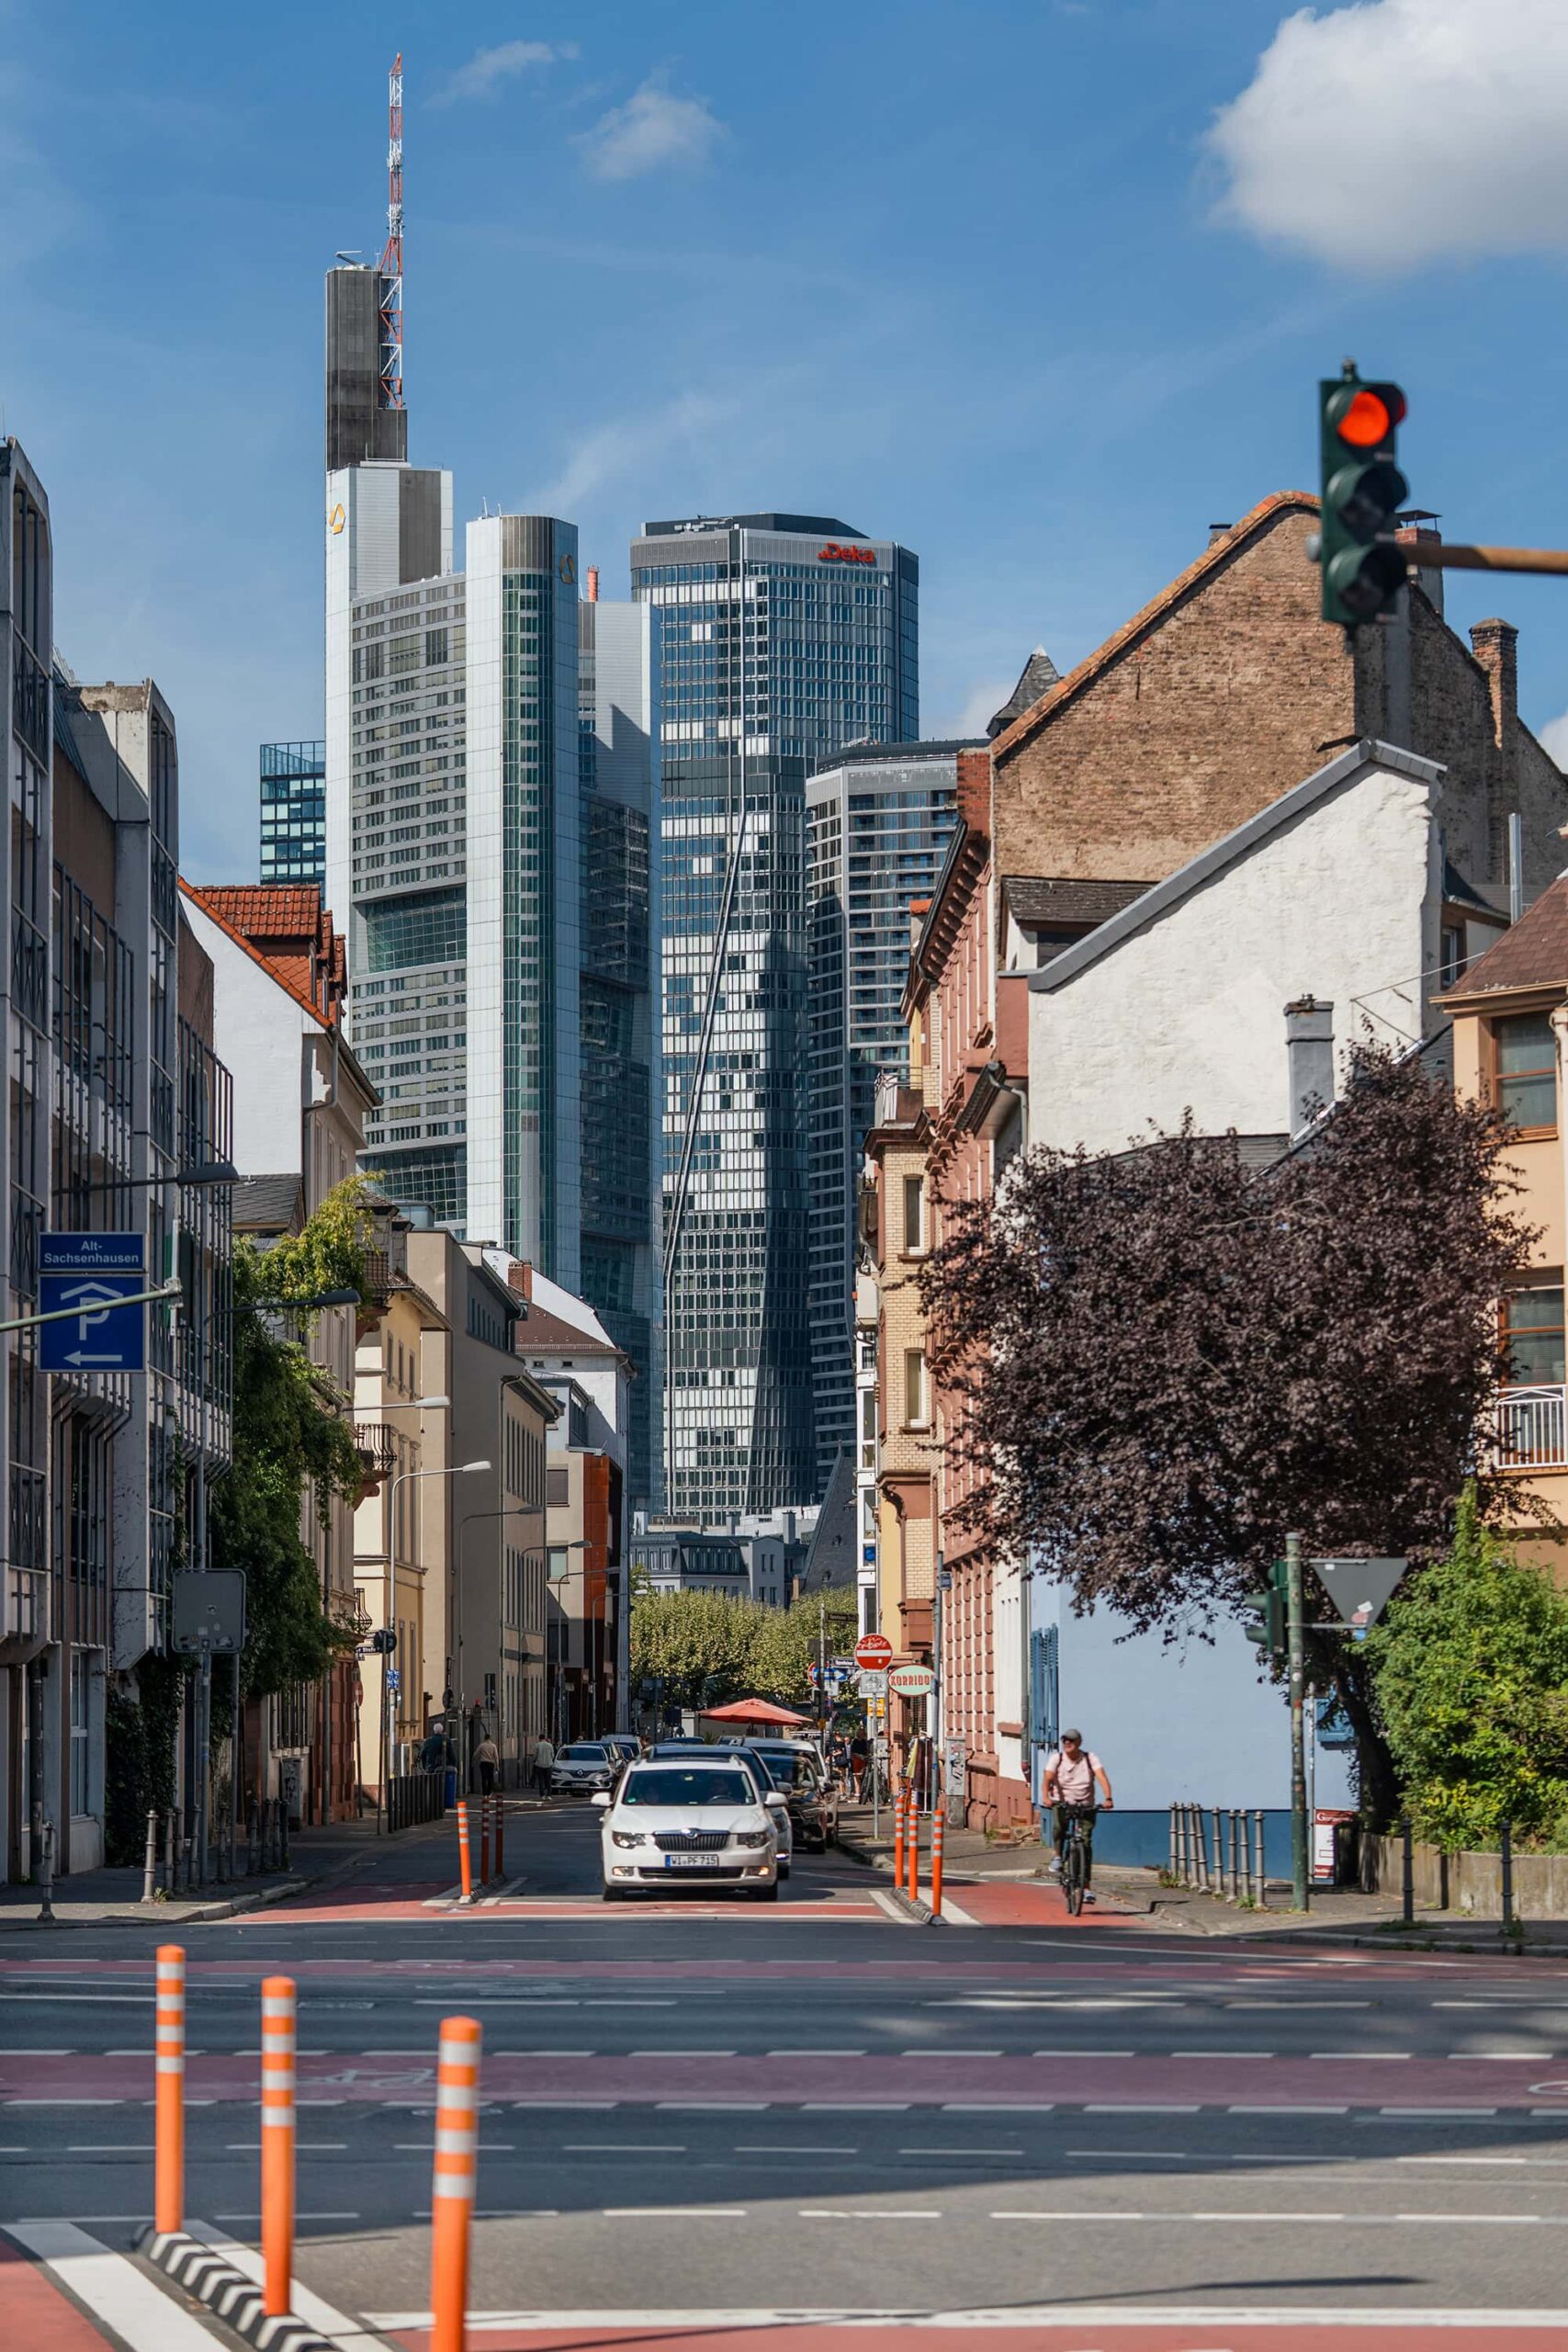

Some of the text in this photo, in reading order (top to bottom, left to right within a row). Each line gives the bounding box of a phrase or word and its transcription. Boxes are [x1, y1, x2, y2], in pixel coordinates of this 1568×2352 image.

[825, 542, 875, 563] Deka
[81, 1240, 103, 1251] Alt-
[43, 1252, 140, 1263] Sachsenhausen
[79, 1296, 110, 1341] P
[890, 1675, 933, 1687] KORRIDO
[671, 1856, 716, 1865] WI PF 715
